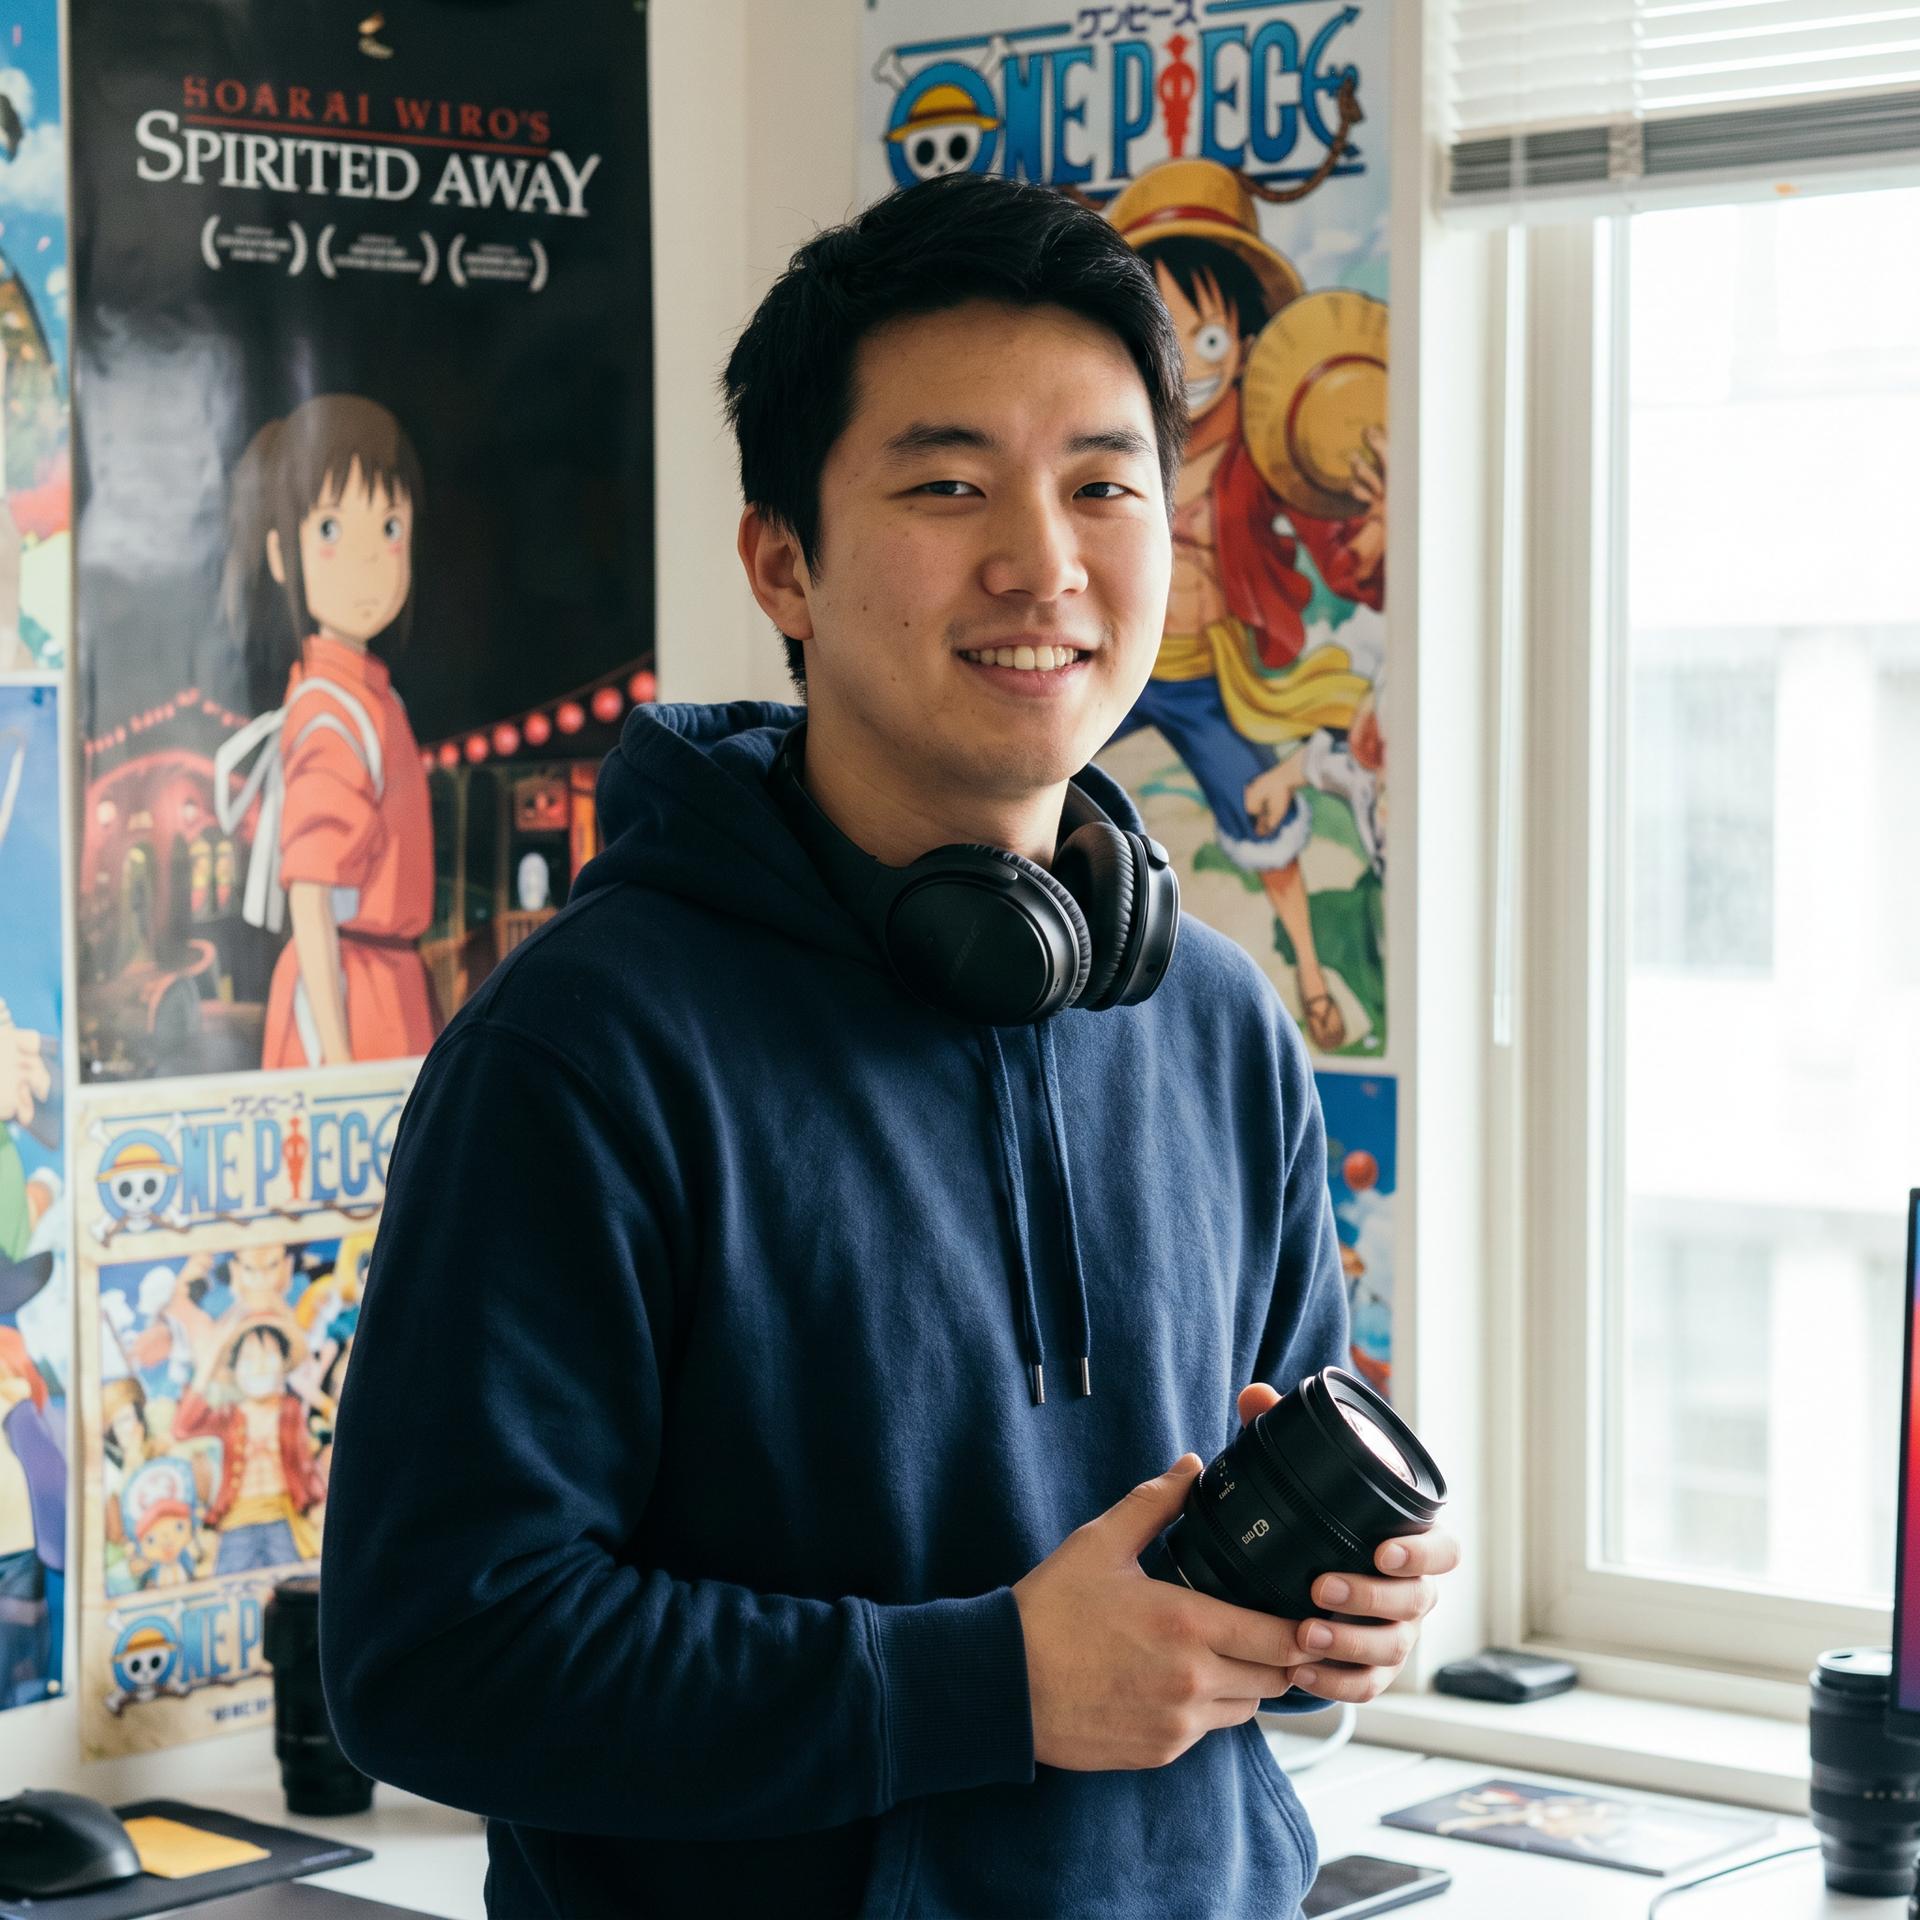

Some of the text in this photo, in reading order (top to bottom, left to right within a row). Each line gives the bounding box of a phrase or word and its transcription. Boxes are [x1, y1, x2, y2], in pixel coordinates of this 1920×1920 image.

[135, 110, 601, 217] SPIRITED AWAY
[885, 44, 1094, 188] ONE
[97, 1121, 244, 1231] ONE
